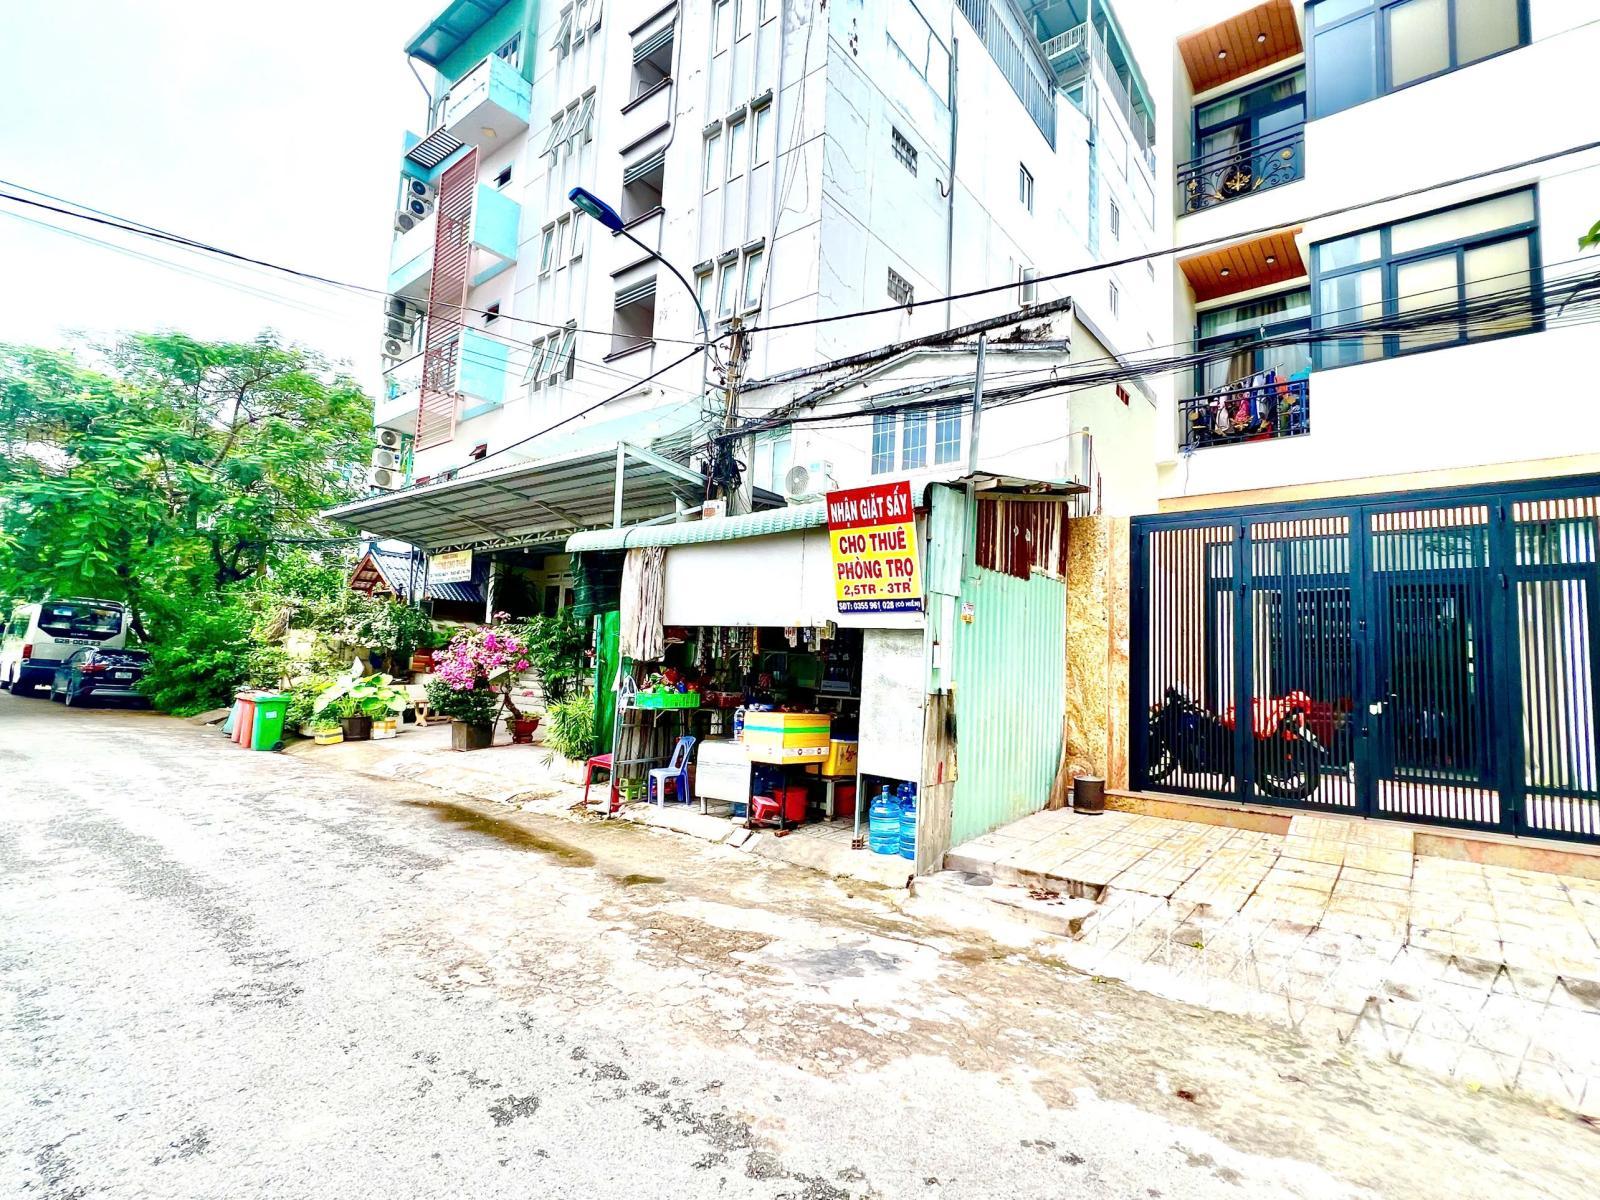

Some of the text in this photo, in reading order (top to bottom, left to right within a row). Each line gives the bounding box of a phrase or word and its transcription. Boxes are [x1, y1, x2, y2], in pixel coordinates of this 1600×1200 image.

[830, 485, 908, 527] NHẬN GIẶT SẤY
[839, 527, 906, 554] CHO THUÊ
[837, 557, 914, 582] PHÒNG TRỌ
[843, 584, 877, 597] 2,5TR
[887, 582, 911, 593] 3TR
[854, 601, 869, 610] 0355
[869, 601, 881, 610] 961
[882, 600, 895, 609] 028
